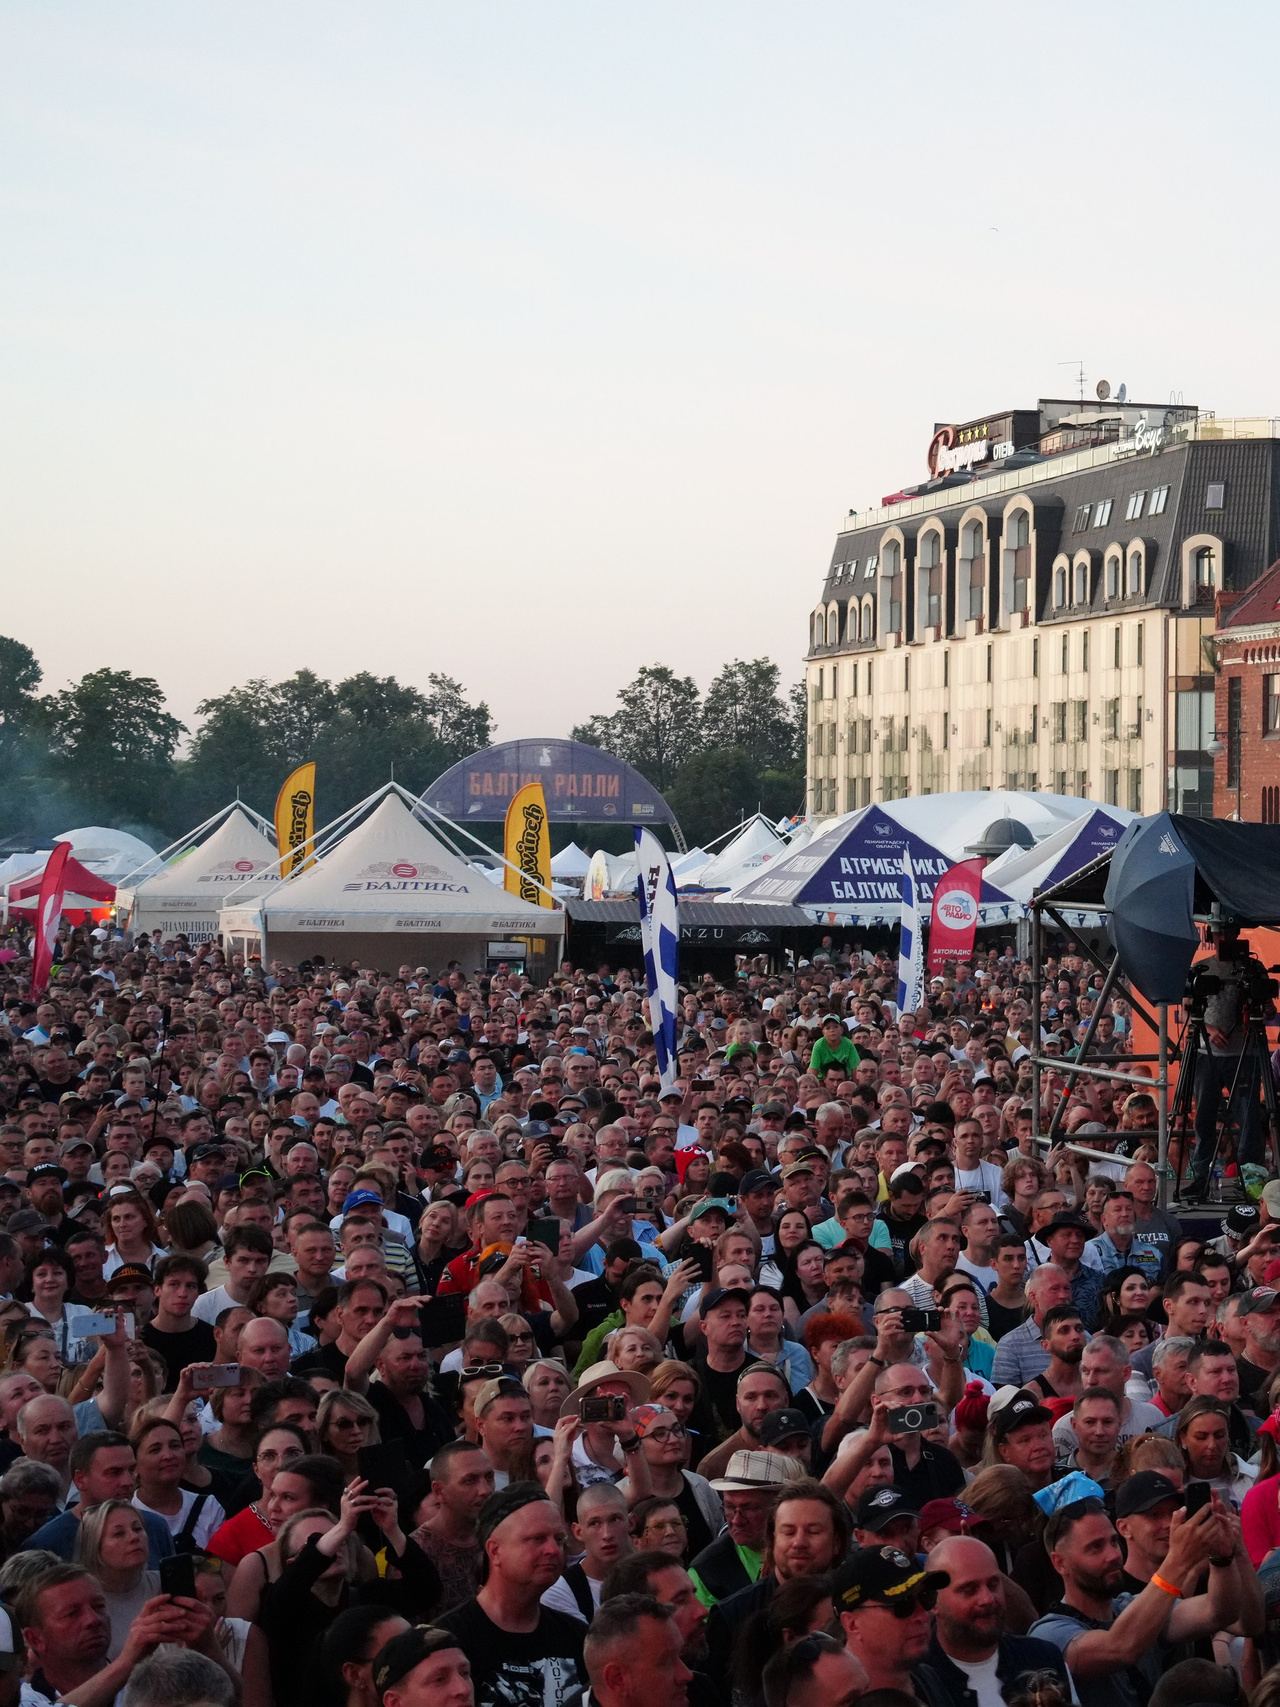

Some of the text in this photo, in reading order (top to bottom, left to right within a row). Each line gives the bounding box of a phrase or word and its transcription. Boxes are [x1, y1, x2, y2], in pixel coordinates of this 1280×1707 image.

[555, 774, 620, 797] РАЛЛИ
[839, 857, 949, 876] АТРИБУИКА
[213, 874, 281, 882] БАЛТИК
[365, 881, 470, 894] БАЛТИКА
[830, 880, 903, 899] БАЛТИК
[940, 904, 962, 913] АВТО
[945, 911, 972, 920] РАДИО
[160, 921, 220, 932] ЗНАМЕНИТО
[305, 919, 345, 927] БАЛТИКА
[403, 920, 442, 928] БАЛТИКА
